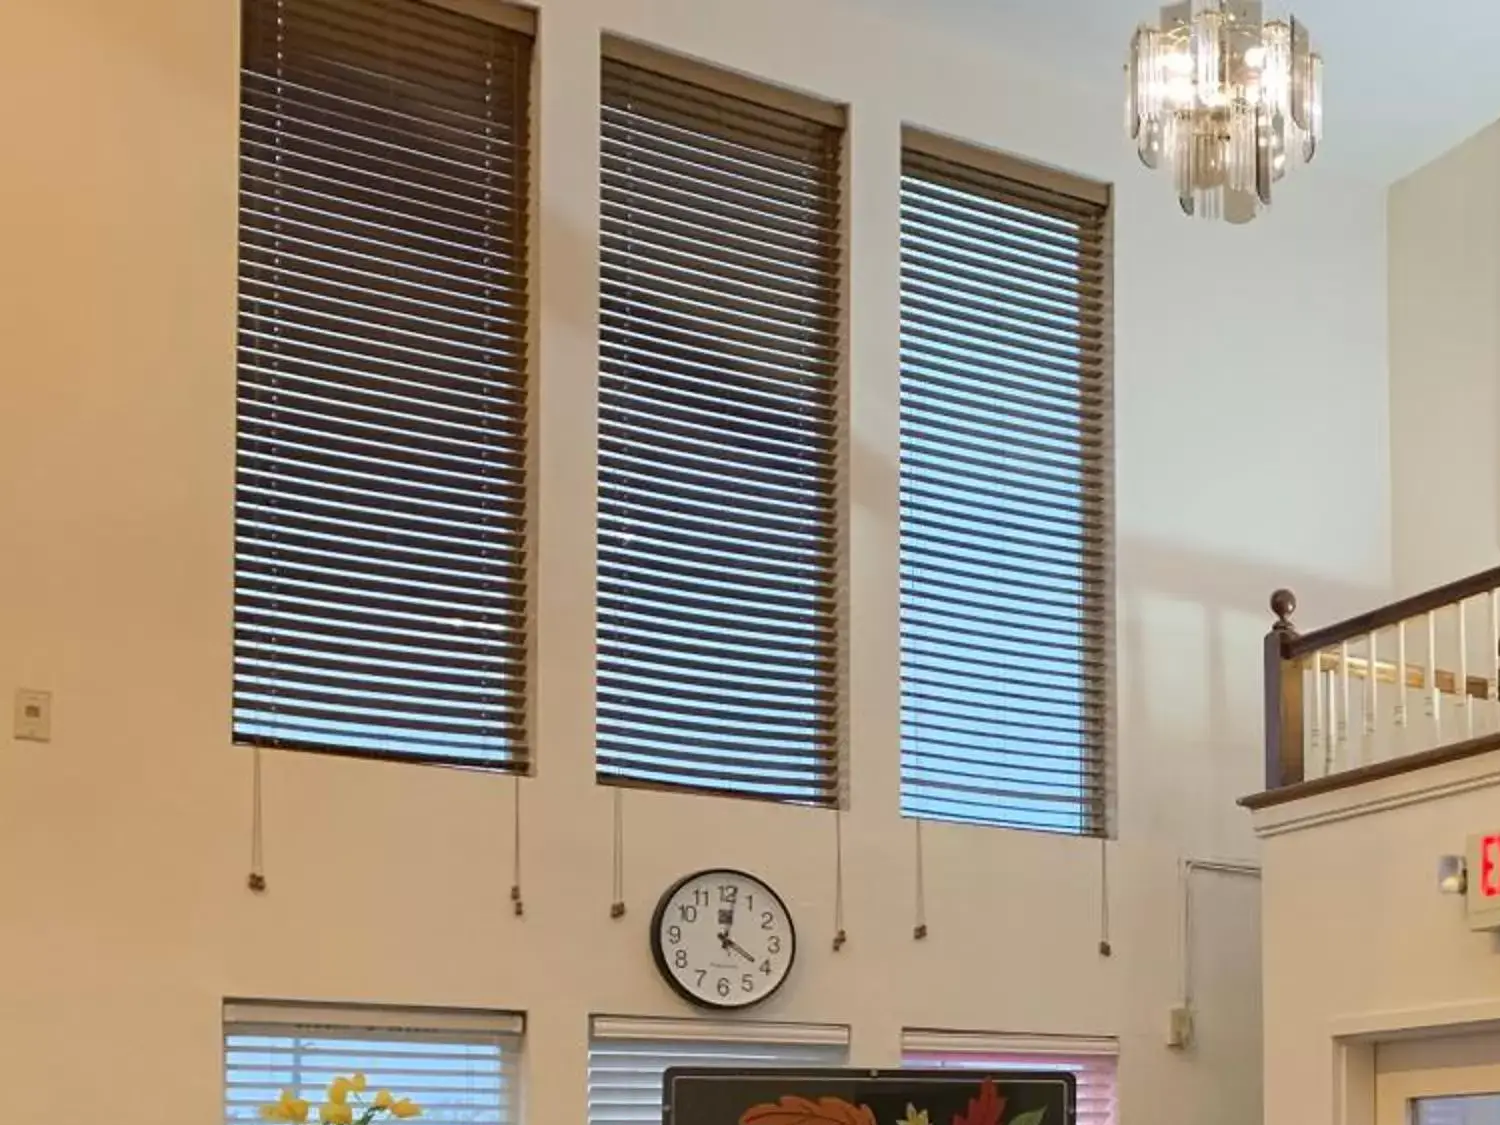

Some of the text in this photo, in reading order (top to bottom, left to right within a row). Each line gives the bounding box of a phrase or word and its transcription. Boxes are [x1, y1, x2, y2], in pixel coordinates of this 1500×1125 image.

[693, 888, 709, 907] 11
[717, 884, 738, 904] 12
[745, 895, 753, 912] 1
[679, 904, 697, 923] 10
[761, 911, 774, 930] 2
[668, 925, 681, 944] 9
[767, 935, 781, 954] 3
[675, 950, 688, 968] 8
[759, 959, 772, 976] 4
[694, 969, 707, 987] 7
[717, 977, 730, 997] 6
[741, 974, 754, 992] 5
